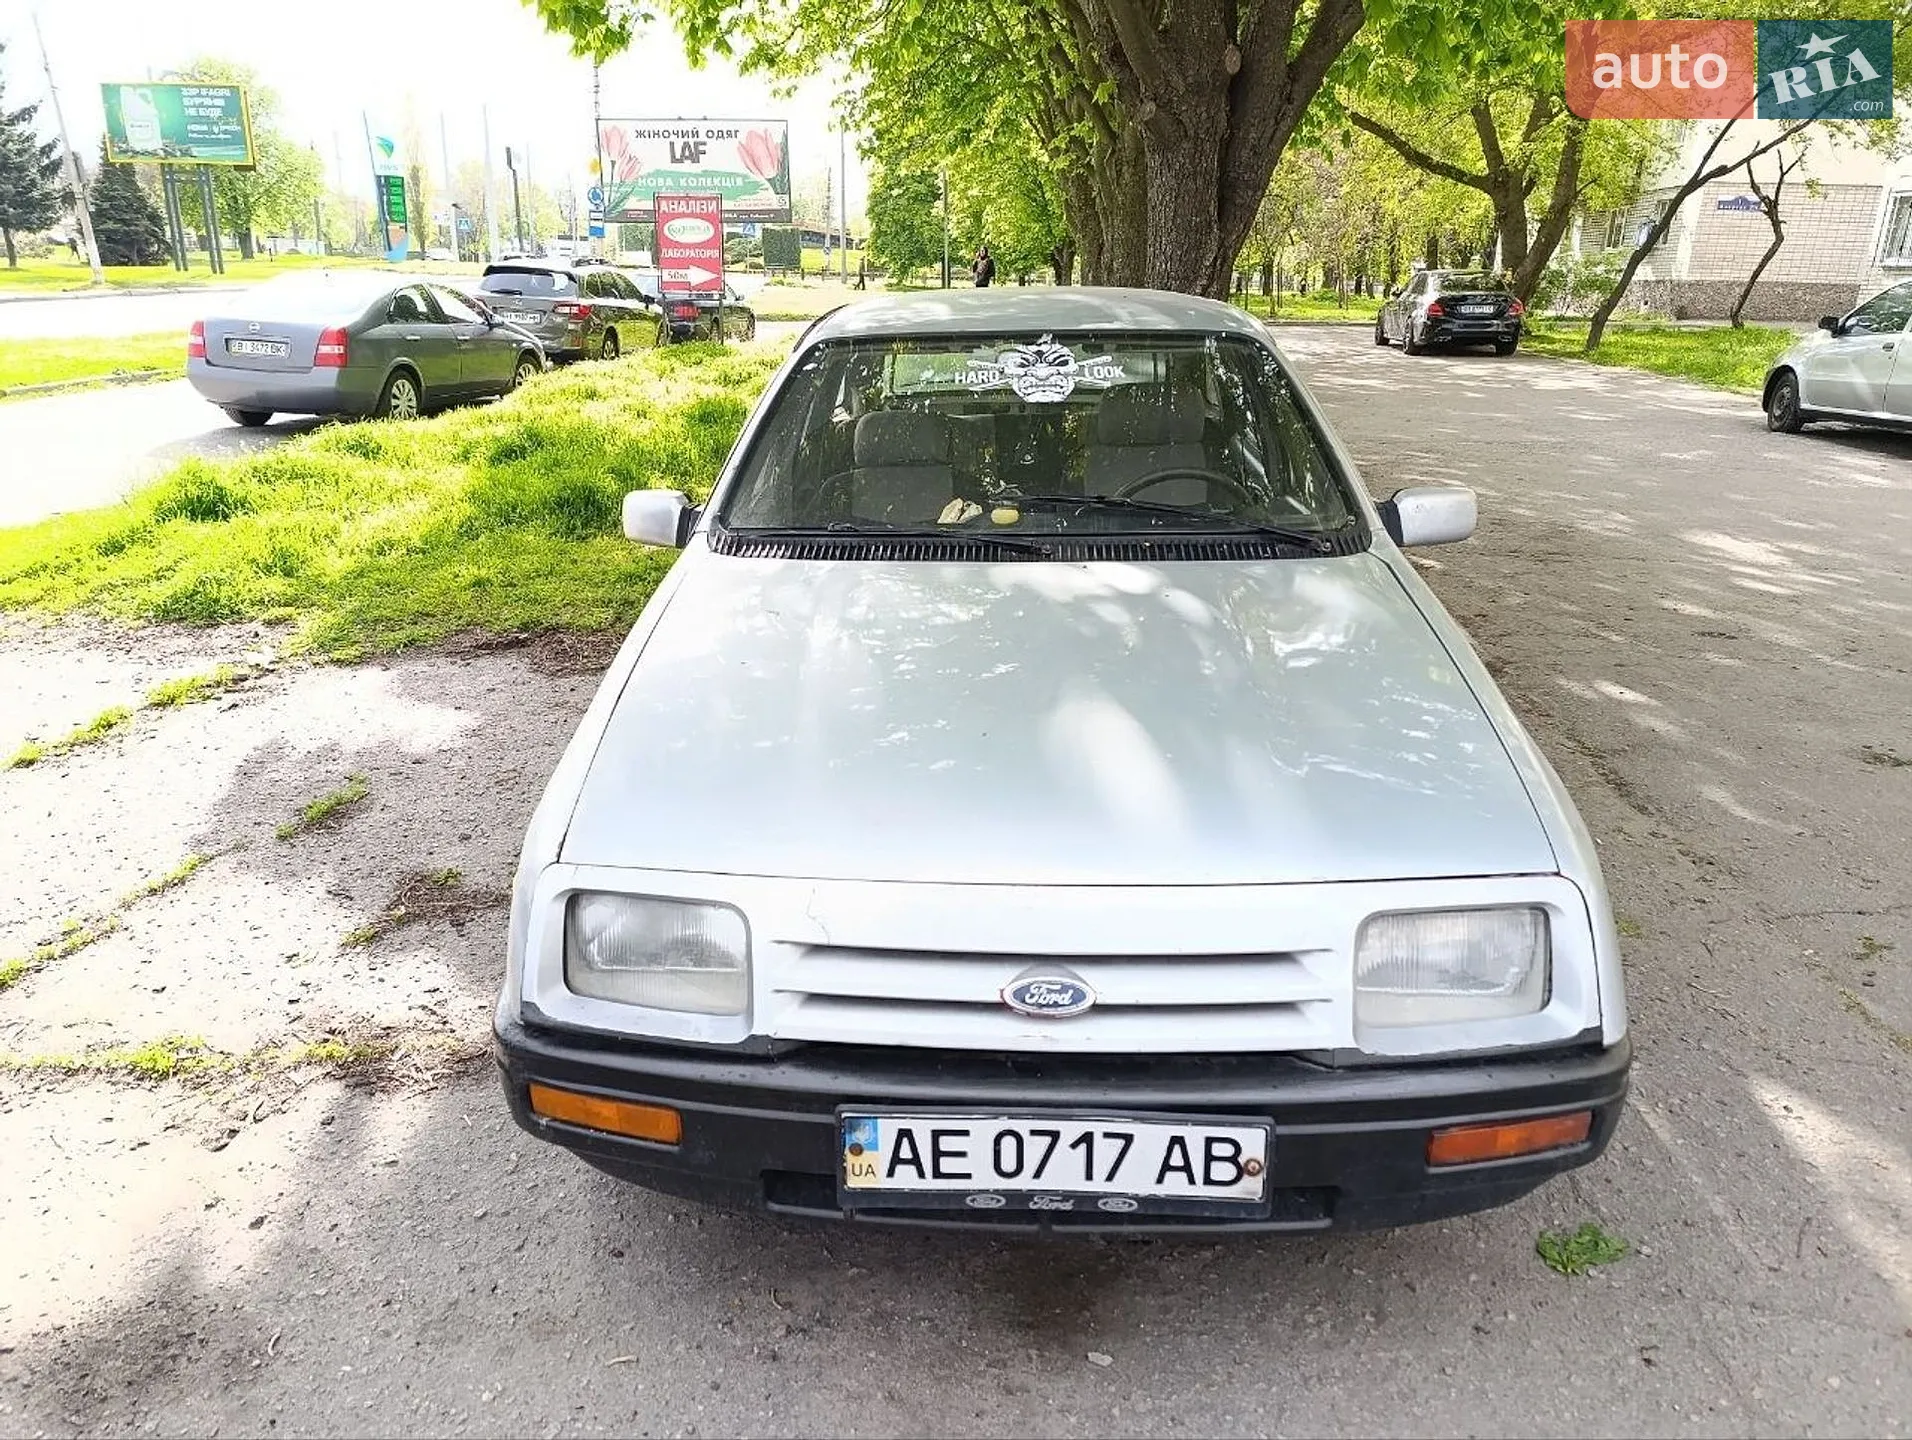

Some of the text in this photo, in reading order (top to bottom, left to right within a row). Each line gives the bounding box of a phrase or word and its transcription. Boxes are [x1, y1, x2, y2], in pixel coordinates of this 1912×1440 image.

[634, 127, 741, 141] ЖІНОЧИЙ ОДЯГ
[669, 141, 707, 164] LAF
[637, 176, 744, 188] НОВА КОЛЕКЦІЯ
[660, 199, 717, 213] АНАЛІЗИ
[660, 247, 720, 259] ЛАБОРАТОРІЯ
[954, 370, 1001, 384] HARD
[1084, 364, 1127, 380] LOOK
[1024, 982, 1074, 1006] Ford
[886, 1128, 1246, 1187] AE 0717 AB
[851, 1162, 877, 1179] UA
[1028, 1194, 1075, 1211] Ford
